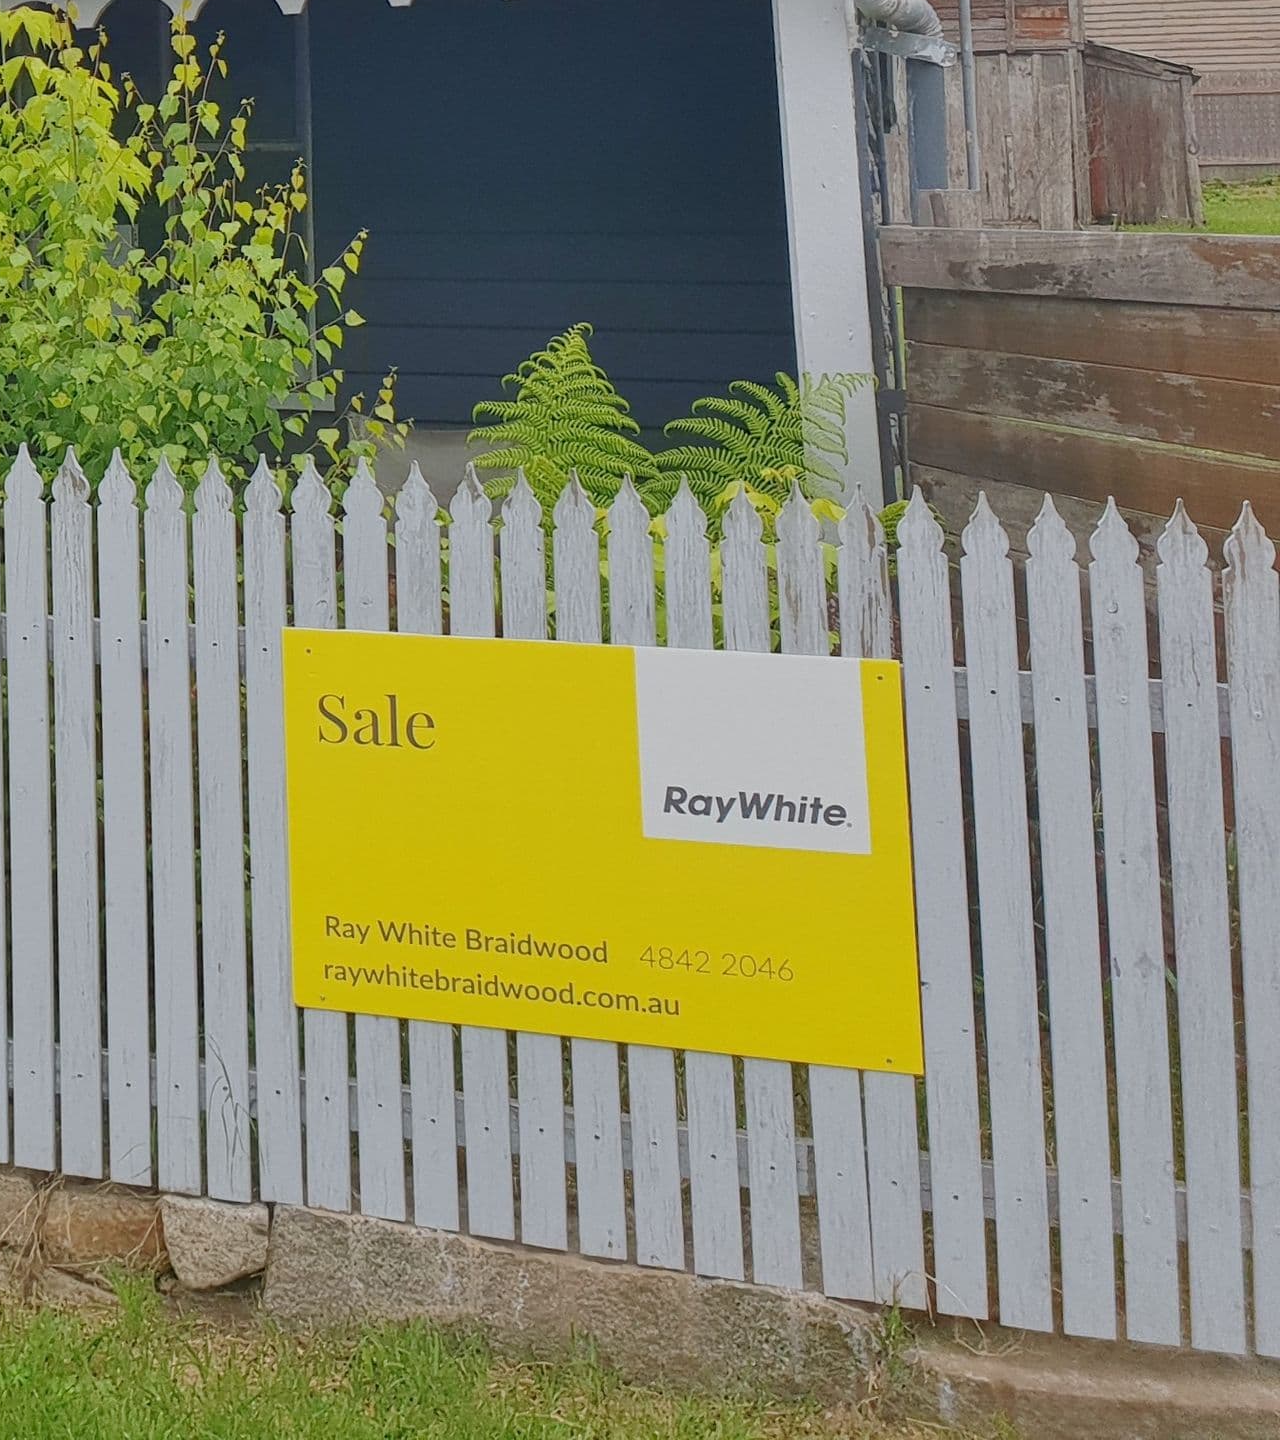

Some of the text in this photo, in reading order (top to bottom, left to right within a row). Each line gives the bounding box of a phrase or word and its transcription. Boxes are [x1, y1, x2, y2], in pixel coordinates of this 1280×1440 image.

[317, 693, 436, 750] Sale
[324, 915, 609, 964] Ray White Braidwood
[639, 944, 794, 982] 4842 2046
[323, 962, 681, 1017] raywhitebraidwood.com.au
